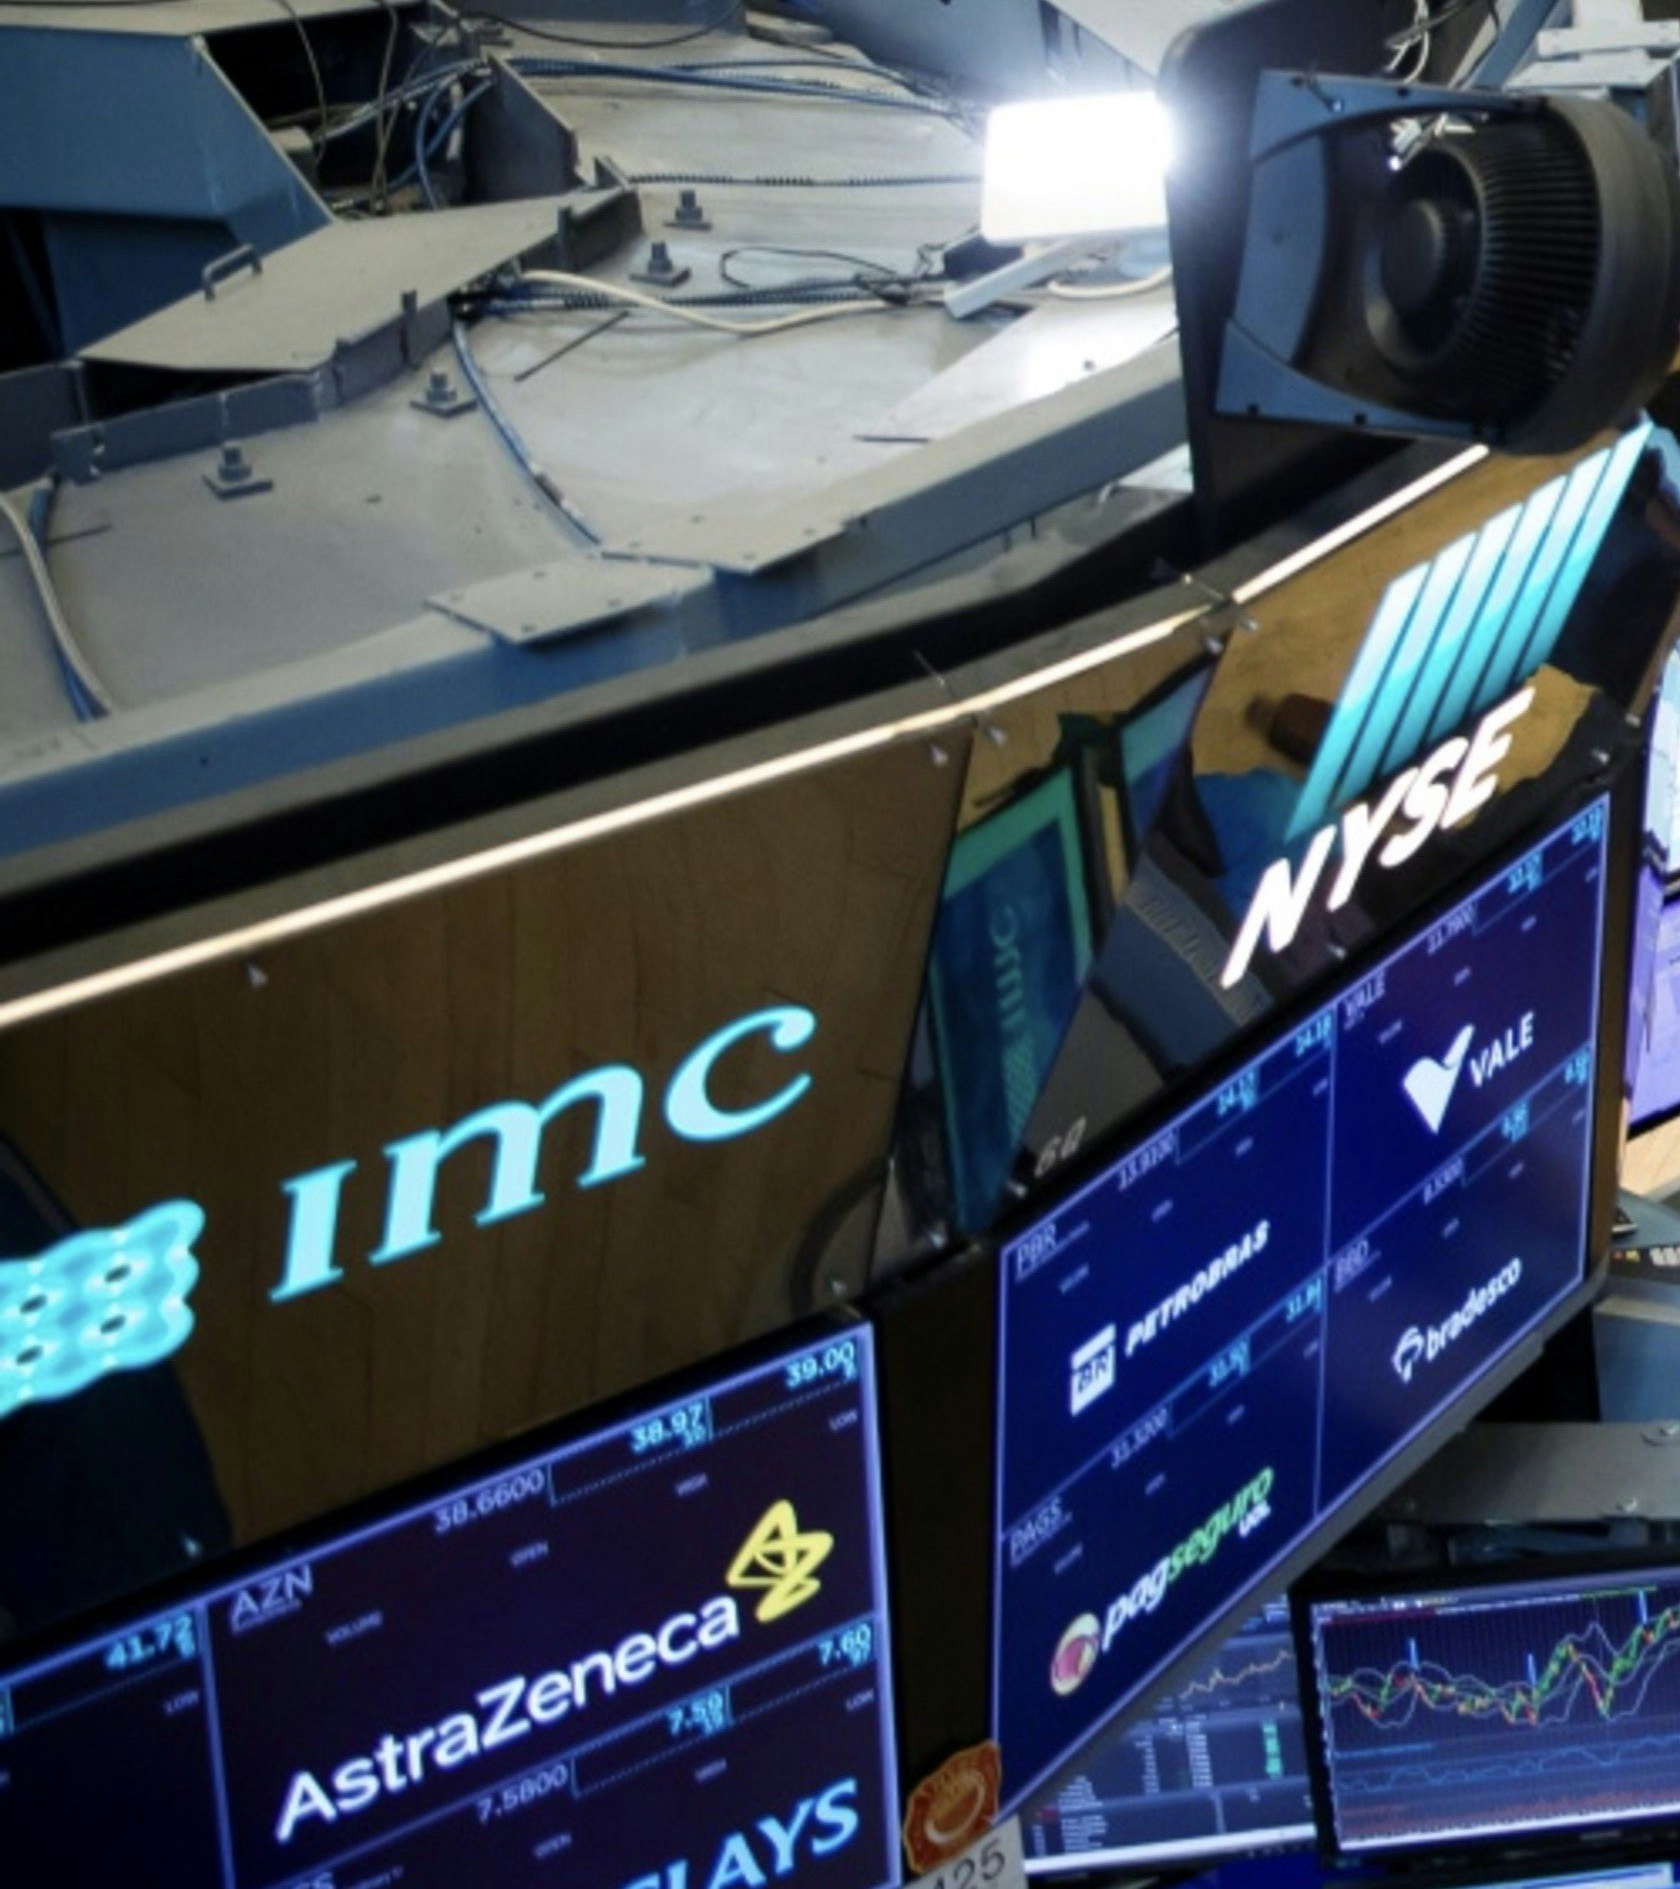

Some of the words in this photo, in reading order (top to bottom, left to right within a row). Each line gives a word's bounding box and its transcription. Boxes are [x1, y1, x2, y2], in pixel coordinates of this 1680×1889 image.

[1221, 687, 1535, 990] NYSE
[1469, 1012, 1535, 1088] VALE
[270, 1006, 816, 1301] imc
[1125, 1220, 1270, 1358] PETROBRAS
[1425, 1257, 1523, 1361] bradesco
[434, 1467, 546, 1534] 38.6600
[1010, 1497, 1067, 1556] PAGS
[231, 1563, 314, 1628] AZN
[1101, 1466, 1276, 1653] pagseguro
[326, 1611, 383, 1646] VOLUME
[276, 1596, 739, 1842] AstraZeneca
[476, 1766, 568, 1825] 7.5800
